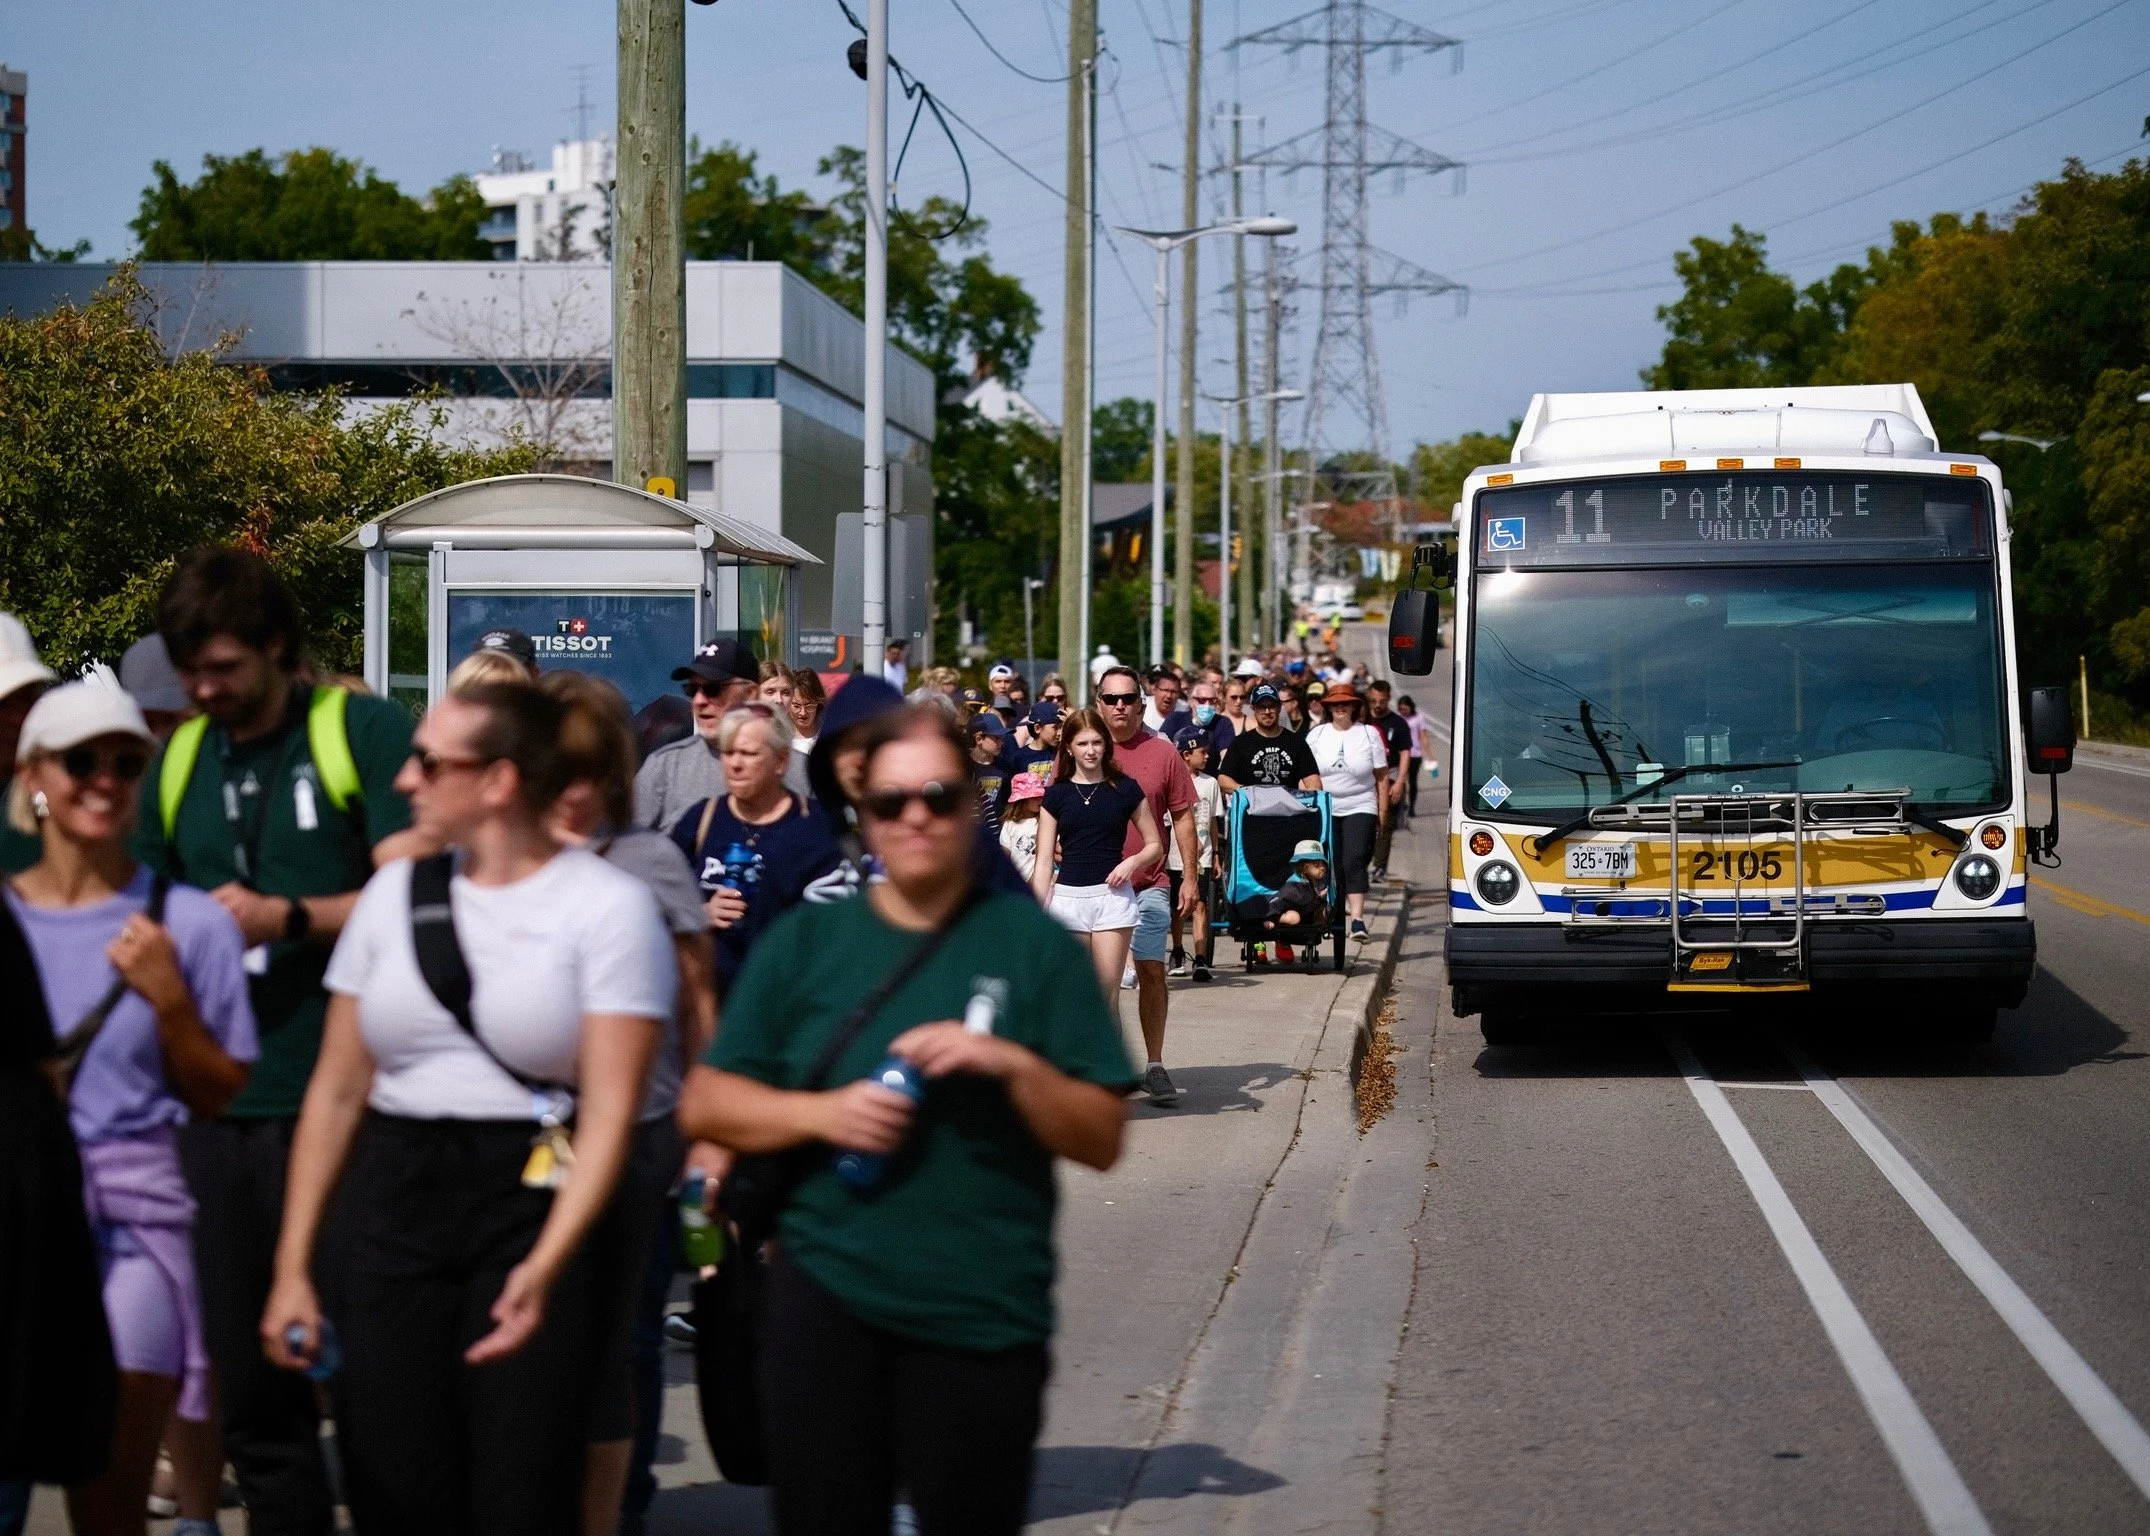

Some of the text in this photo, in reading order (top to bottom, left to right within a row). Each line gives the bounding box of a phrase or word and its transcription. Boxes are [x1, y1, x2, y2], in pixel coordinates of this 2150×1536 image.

[1660, 484, 1870, 520] PARKDALE
[1555, 489, 1611, 544] 11
[1699, 518, 1832, 541] VALLEY PARK
[531, 635, 612, 651] TISSOT
[1187, 739, 1197, 749] 13
[1482, 787, 1507, 797] CNG
[1572, 852, 1629, 869] 325 7BM
[1692, 850, 1782, 882] 2105
